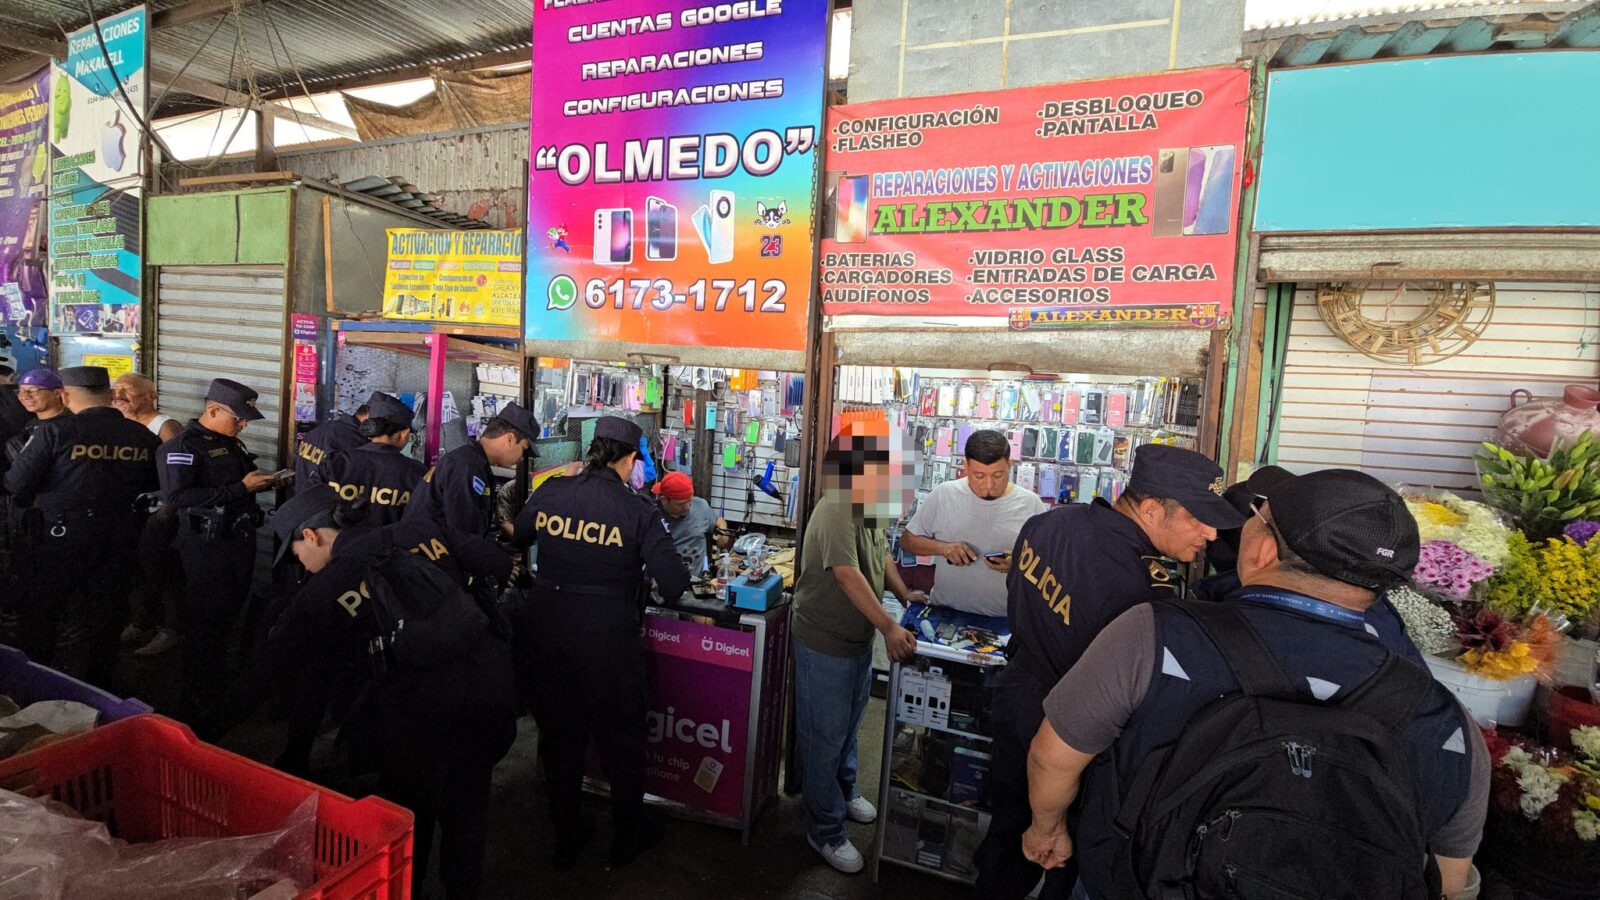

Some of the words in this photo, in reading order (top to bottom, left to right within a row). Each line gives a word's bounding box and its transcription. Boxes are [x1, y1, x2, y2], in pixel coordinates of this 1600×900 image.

[568, 12, 672, 43] CUENTAS
[680, 0, 782, 28] GOOGLE
[581, 41, 764, 81] REPARACIONES
[563, 78, 784, 117] CONFIGURACIONES
[1043, 90, 1204, 118] DESBLOQUEO
[837, 105, 999, 135] CONFIGURACIÓN
[1042, 113, 1158, 137] PANTALLA
[838, 131, 923, 152] FLASHEO
[535, 125, 815, 186] “OLMEDO”
[873, 166, 998, 198] REPARACIONES
[1001, 165, 1016, 190] Y
[1017, 156, 1153, 192] ACTIVACIONES
[871, 192, 1149, 236] ALEXANDER
[454, 233, 461, 255] Y
[759, 234, 782, 258] 23
[825, 251, 915, 267] BATERIAS
[974, 249, 1045, 266] VIDRIO
[1052, 247, 1124, 263] GLASS
[824, 269, 953, 285] CARGADORES
[972, 268, 1086, 284] ENTRADAS
[1092, 266, 1124, 282] DE
[1130, 264, 1217, 281] CARGA
[584, 278, 787, 312] 6173-1712
[823, 285, 931, 304] AUDÍFONOS
[971, 288, 1110, 304] ACCESORIOS
[1035, 308, 1189, 323] ALEXANDER
[70, 444, 150, 462] POLICIA
[299, 440, 327, 466] OLICI
[328, 481, 411, 506] OICIA
[535, 511, 624, 548] POLICIA
[1376, 547, 1395, 559] FGR
[1018, 538, 1072, 626] POLICIA
[648, 628, 681, 644] Digicel
[715, 641, 750, 657] Digicel
[667, 755, 691, 771] chip
